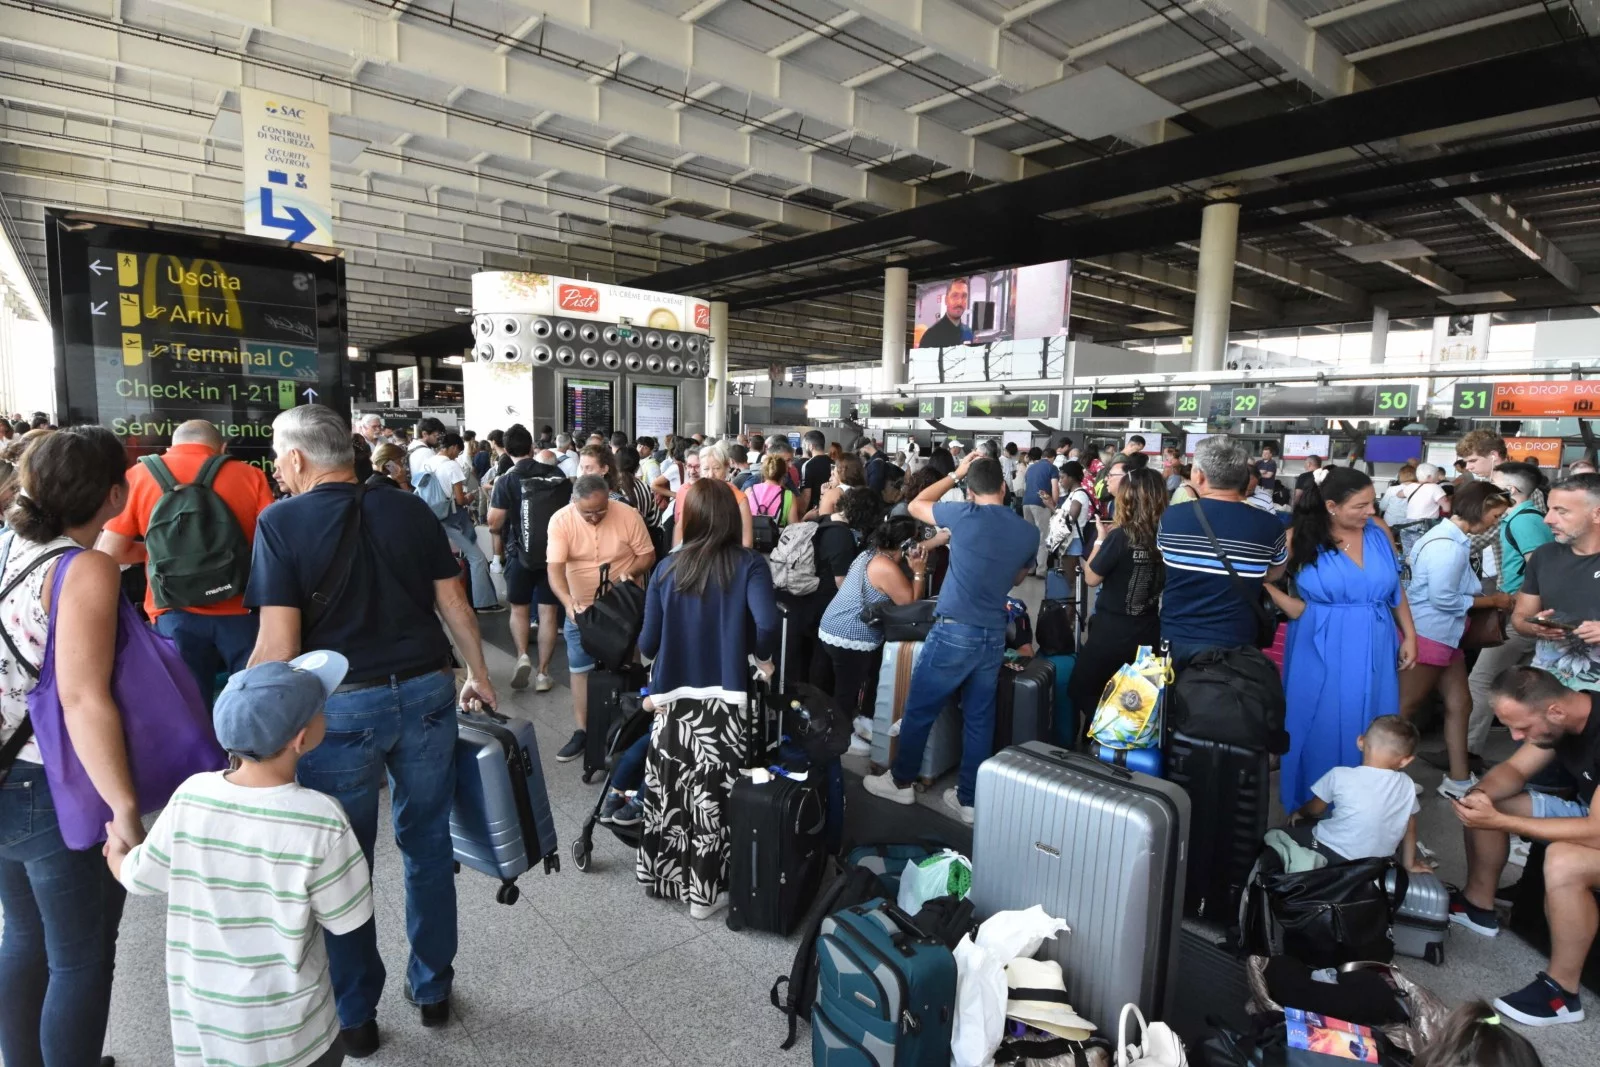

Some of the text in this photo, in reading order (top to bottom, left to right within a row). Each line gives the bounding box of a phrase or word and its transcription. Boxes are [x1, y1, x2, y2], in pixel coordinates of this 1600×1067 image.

[281, 106, 306, 120] SAC
[257, 131, 315, 150] DI SICUREZZA
[261, 124, 311, 142] CONTROLLI
[264, 154, 311, 169] CONTROLS
[267, 147, 308, 161] SECURITY
[166, 266, 242, 291] Uscita
[562, 288, 598, 309] Pisti
[169, 304, 230, 326] Arrivi
[170, 342, 294, 368] Terminal C
[115, 378, 272, 402] Check-in 1-21
[1497, 386, 1525, 395] BAG
[1528, 385, 1568, 394] DROP
[920, 402, 933, 413] 24
[952, 400, 965, 413] 25
[1031, 400, 1046, 412] 26
[1074, 399, 1090, 412] 27
[1178, 396, 1197, 412] 28
[1234, 395, 1257, 411] 29
[1378, 392, 1408, 409] 30
[1460, 390, 1487, 409] 31
[830, 403, 840, 414] 22
[859, 403, 868, 414] 23
[112, 418, 177, 436] Servi
[1506, 442, 1559, 451] AG DROP
